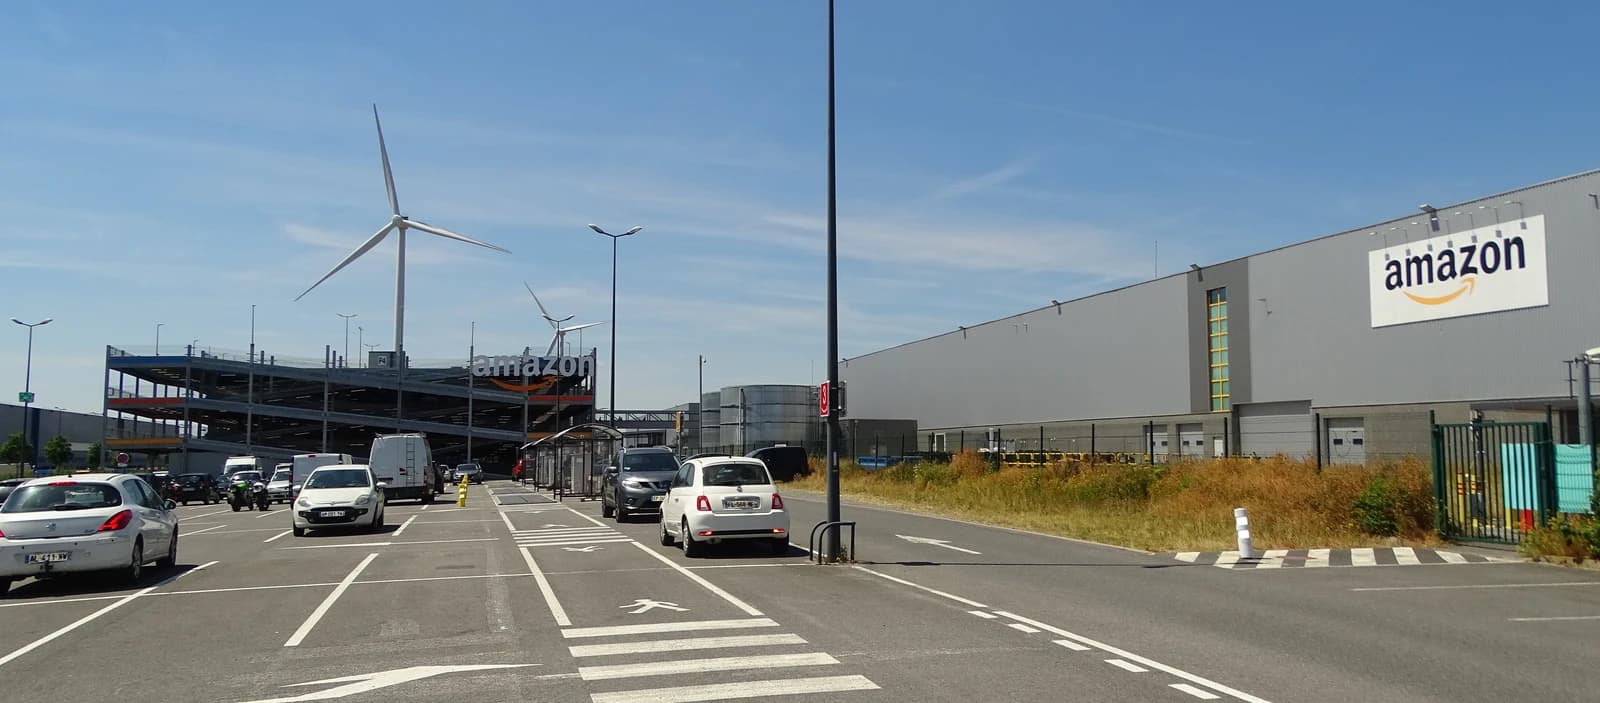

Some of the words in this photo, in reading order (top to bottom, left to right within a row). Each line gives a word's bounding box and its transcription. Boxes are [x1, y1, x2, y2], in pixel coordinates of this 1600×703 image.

[1385, 235, 1526, 291] amazon
[471, 355, 595, 377] amazon
[822, 384, 828, 405] 3
